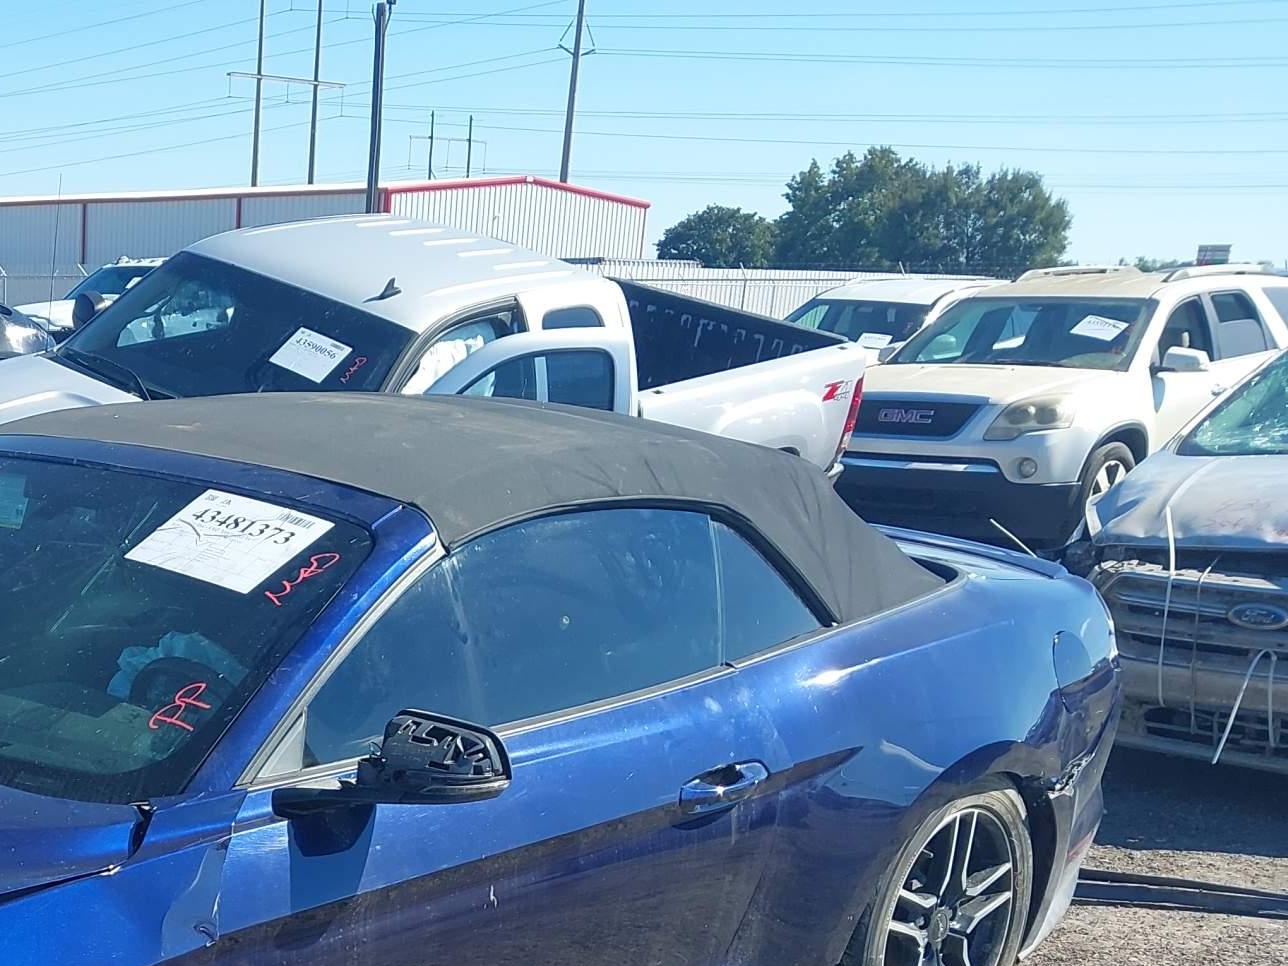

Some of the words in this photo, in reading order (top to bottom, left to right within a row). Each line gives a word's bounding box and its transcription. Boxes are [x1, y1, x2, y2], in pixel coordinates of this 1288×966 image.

[295, 337, 337, 360] 43590056
[878, 408, 934, 423] GMC
[192, 508, 296, 545] 43481373
